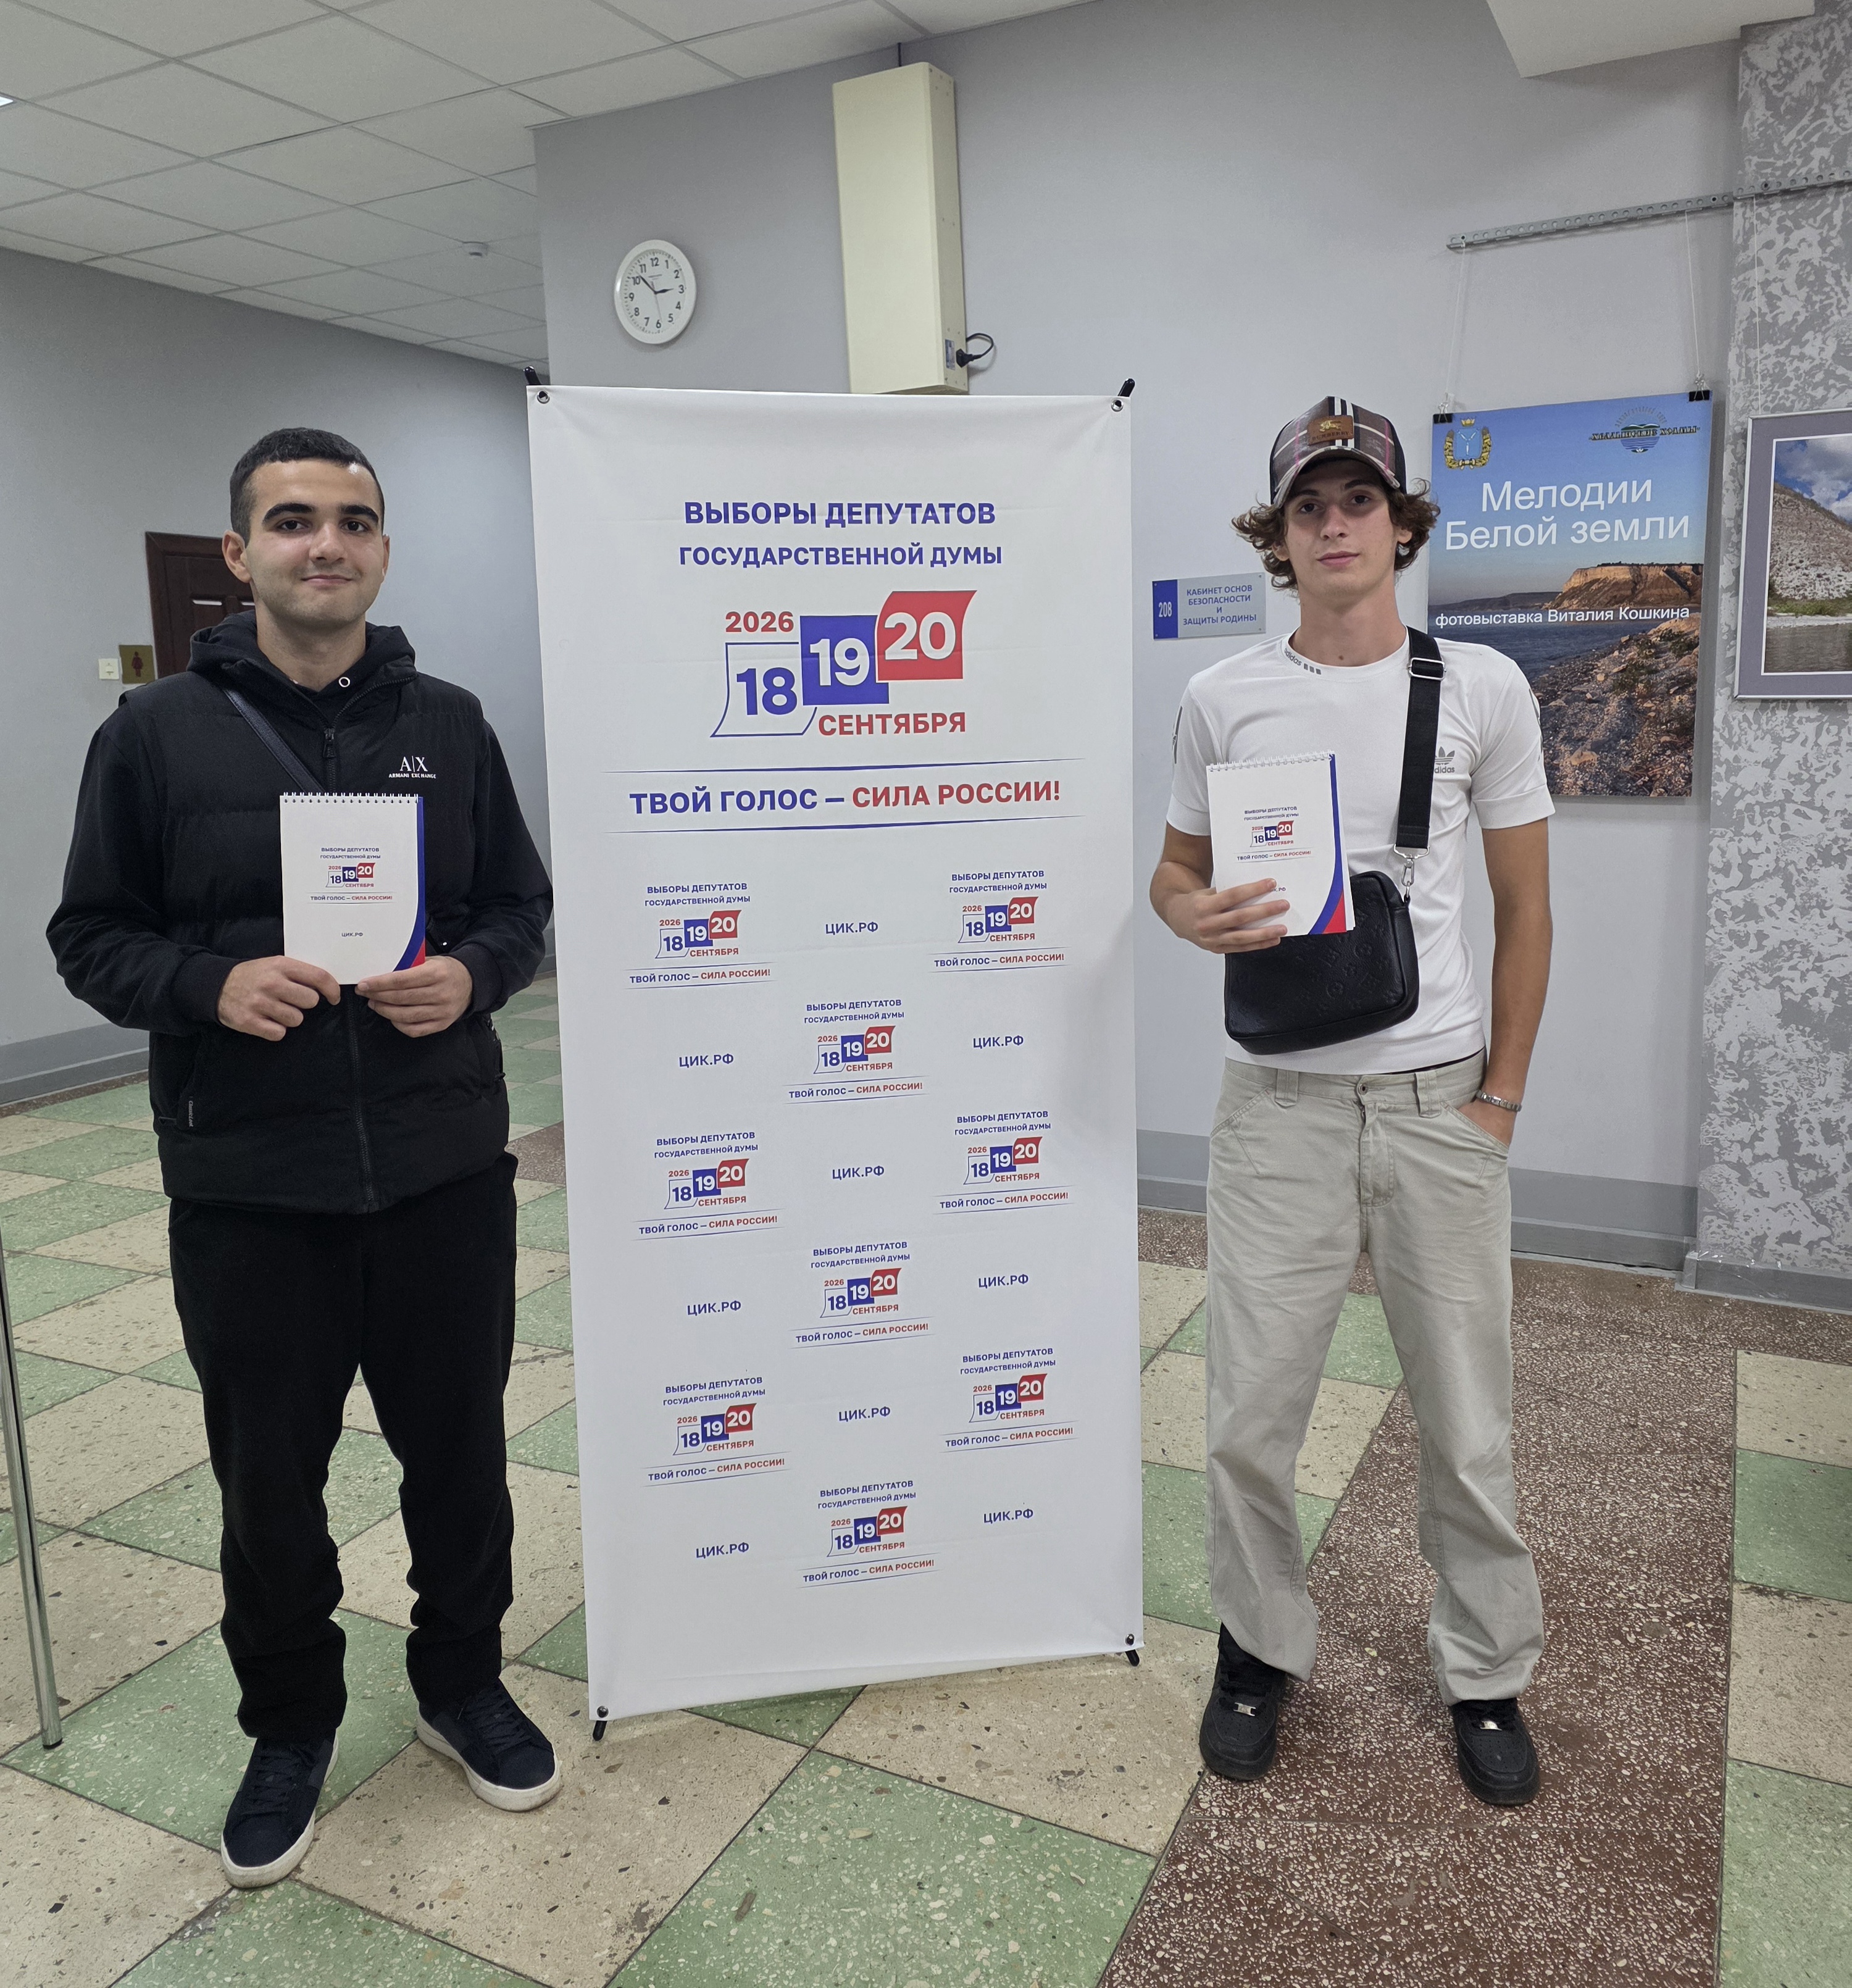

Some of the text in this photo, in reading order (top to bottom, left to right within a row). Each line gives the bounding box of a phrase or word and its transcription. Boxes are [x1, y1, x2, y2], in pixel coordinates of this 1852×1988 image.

[640, 264, 646, 273] 11
[650, 257, 659, 267] 12
[665, 260, 669, 269] 1
[632, 276, 641, 286] 10
[674, 270, 680, 278] 2
[678, 285, 684, 293] 3
[629, 292, 635, 301] 9
[634, 307, 640, 316] 8
[675, 301, 681, 310] 4
[644, 317, 649, 326] 7
[656, 319, 661, 328] 6
[668, 314, 674, 323] 5
[1482, 480, 1651, 511] Мелодии
[685, 503, 995, 528] ВЫБОРЫ ДЕПУТАТОВ
[1446, 516, 1688, 549] Белой земли
[680, 542, 1001, 568] ГОСУДАРСТВЕННОЙ ДУМЫ
[1187, 587, 1222, 596] КАБИНЕТ
[1188, 595, 1250, 605] БЕЗОПАСНОСТИ
[1159, 601, 1172, 617] 208
[726, 611, 793, 632] 2026
[1183, 614, 1256, 625] ЗАЩИТЫ РОДИНЫ
[1436, 607, 1689, 629] фотовыставка Виталия Кошкина
[736, 612, 956, 715] 18 19 20
[1284, 648, 1302, 666] adidas
[819, 712, 965, 735] СЕНТЯБРЯ
[630, 786, 711, 814] ТВОЙ
[721, 789, 817, 811] ГОЛОС
[853, 785, 930, 808] СИЛА
[938, 781, 1059, 804] РОССИИ!
[1266, 830, 1276, 838] 19
[1278, 824, 1291, 833] 20
[330, 866, 372, 883] 18 19 20
[993, 871, 1044, 880] ДЕПУТАТОВ
[648, 883, 747, 893] ВЫБОРЫ ДЕПУТАТОВ
[949, 883, 1022, 893] ГОСУДАРСТВЕННОЙ
[645, 896, 724, 906] ГОСУДАРСТВЕННОЙ
[966, 903, 1032, 936] 18 19 20
[664, 917, 735, 951] 18 19 20
[826, 922, 878, 935] ЦИК.РФ
[990, 933, 1035, 942] СЕНТЯБРЯ
[690, 948, 738, 957] СЕНТЯБРЯ
[935, 958, 958, 967] ТВОЙ
[1026, 954, 1064, 962] РОССИИ!
[630, 974, 656, 983] ТВОЙ
[659, 974, 690, 982] ГОЛОС
[729, 969, 770, 978] РОССИИ!
[974, 1035, 1023, 1049] ЦИК.РФ
[680, 1054, 733, 1068] ЦИК.РФ
[833, 1166, 884, 1180] ЦИК.РФ
[814, 1242, 907, 1256] ВЫБОРЫ ДЕПУТАТОВ
[811, 1255, 885, 1268] ГОСУДАРСТВЕННОЙ
[979, 1274, 1028, 1288] ЦИК.РФ
[828, 1275, 895, 1310] 18 19 20
[688, 1301, 741, 1316] ЦИК.РФ
[853, 1305, 898, 1314] СЕНТЯБРЯ
[796, 1332, 820, 1342] ТВОЙ
[823, 1331, 852, 1340] ГОЛОС
[863, 1327, 886, 1335] СИЛА
[890, 1324, 928, 1333] РОССИИ!
[963, 1348, 1053, 1362] ВЫБОРЫ ДЕПУТАТОВ
[977, 1380, 1041, 1415] 18 19 20
[839, 1406, 890, 1422] ЦИК.РФ
[1000, 1409, 1044, 1419] СЕНТЯБРЯ
[820, 1481, 913, 1497] ВЫБОРЫ ДЕПУТАТОВ
[819, 1492, 916, 1509] ГОСУДАРСТВЕННОЙ ДУМЫ
[984, 1509, 1033, 1524] ЦИК.РФ
[835, 1513, 901, 1550] 18 19 20
[696, 1542, 749, 1558] ЦИК.РФ
[859, 1542, 904, 1553] СЕНТЯБРЯ
[803, 1572, 827, 1582] ТВОЙ
[830, 1569, 859, 1579] ГОЛОС
[869, 1565, 893, 1573] СИЛА
[896, 1560, 933, 1571] РОССИИ!
